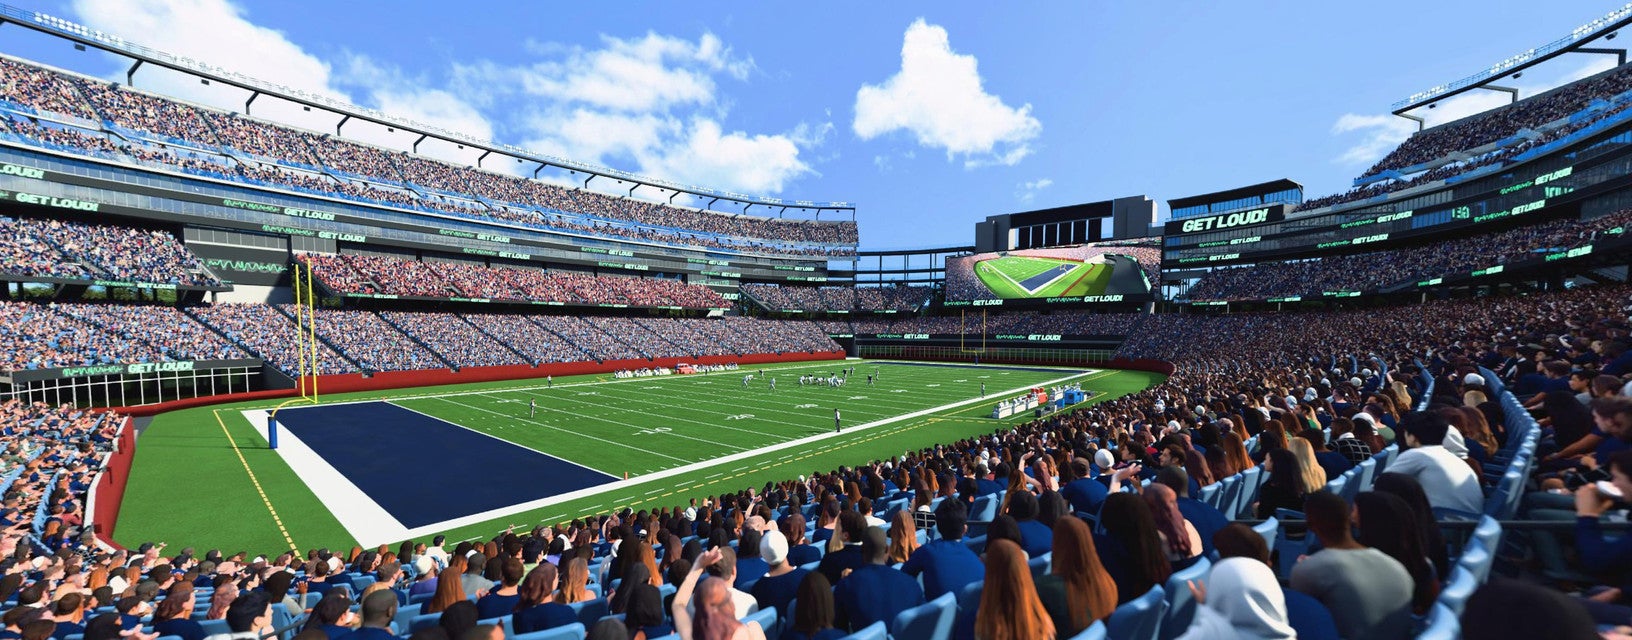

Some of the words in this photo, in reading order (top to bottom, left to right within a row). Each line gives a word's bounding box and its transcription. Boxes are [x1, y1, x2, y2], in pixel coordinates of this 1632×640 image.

[16, 192, 50, 205] GET
[51, 198, 98, 212] LOUD!
[284, 208, 304, 217] GET
[306, 211, 335, 220] LOUD!
[1377, 214, 1393, 223] GET
[1182, 217, 1216, 233] GET
[1217, 209, 1268, 228] LOUD!
[318, 231, 338, 240] GET
[338, 234, 366, 242] LOUD!
[1084, 295, 1100, 303] GET
[128, 363, 154, 374] GET
[155, 362, 194, 371] LOUD!
